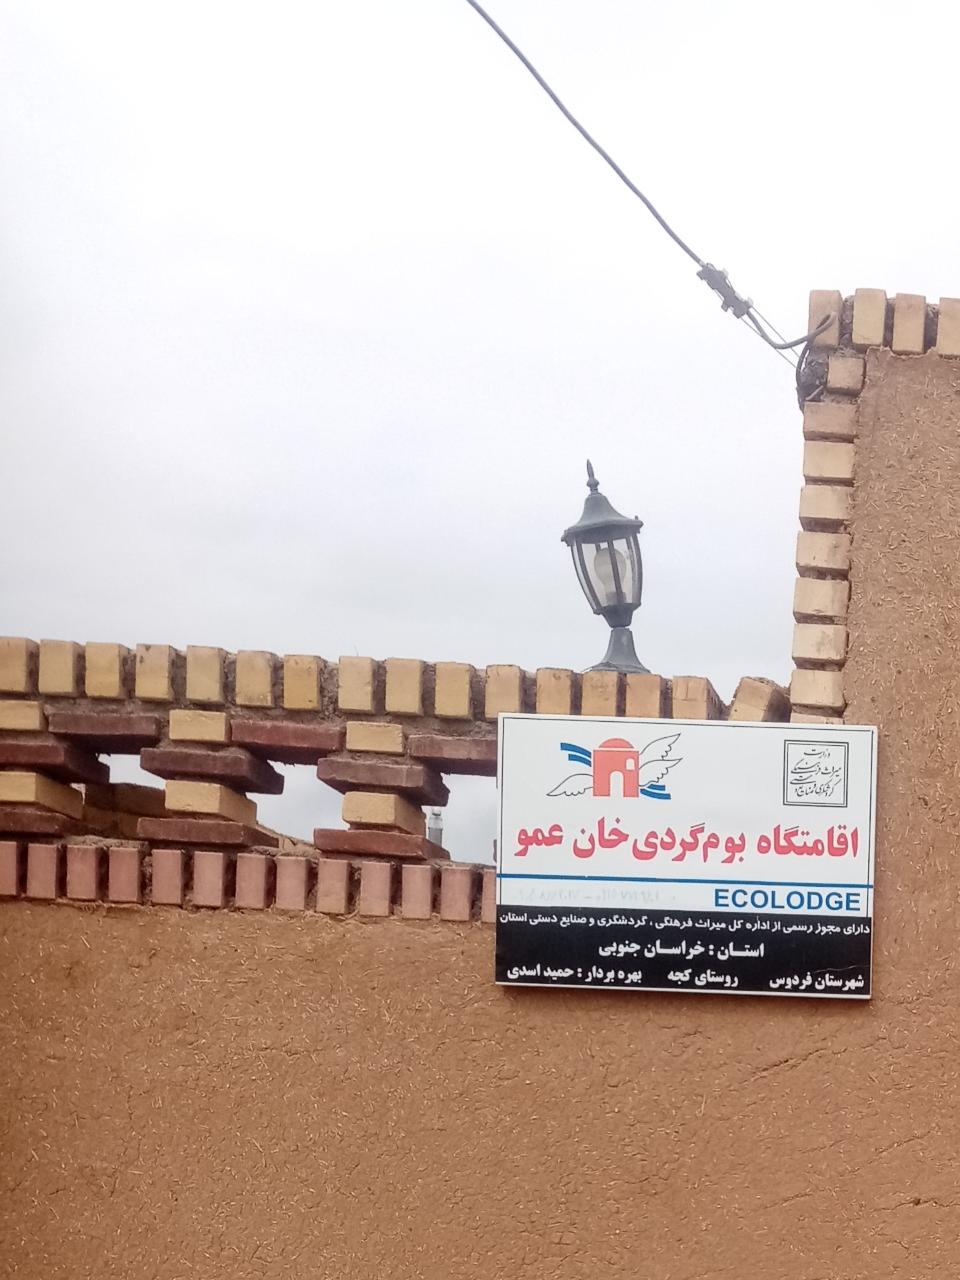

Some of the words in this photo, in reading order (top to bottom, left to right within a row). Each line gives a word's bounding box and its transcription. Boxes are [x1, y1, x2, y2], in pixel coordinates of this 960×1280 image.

[513, 823, 565, 857] عمو
[572, 816, 630, 859] خان
[756, 823, 860, 858] اقامتگاه
[714, 888, 861, 911] ECOLODGE
[499, 912, 528, 924] استان
[528, 914, 558, 926] دستی
[559, 914, 587, 928] صنایع
[588, 917, 595, 927] و
[597, 914, 648, 927] گردشگری
[655, 916, 693, 930] فرهنگی
[695, 917, 727, 931] میراث
[728, 919, 744, 932] کل
[745, 919, 770, 932] اداره
[771, 920, 781, 933] از
[782, 922, 814, 935] رسمی
[815, 922, 842, 936] مجوز
[843, 923, 871, 936] دارای
[598, 939, 641, 958] جنوبی
[643, 938, 706, 960] خراسان
[716, 941, 765, 961] استان
[506, 963, 541, 980] اسدی
[543, 965, 575, 981] حمید
[585, 965, 615, 984] بردار
[617, 967, 643, 984] بهره
[667, 968, 693, 985] کجه
[694, 968, 739, 988] روستای
[769, 971, 813, 990] فردوس
[814, 973, 865, 991] شهرستان
